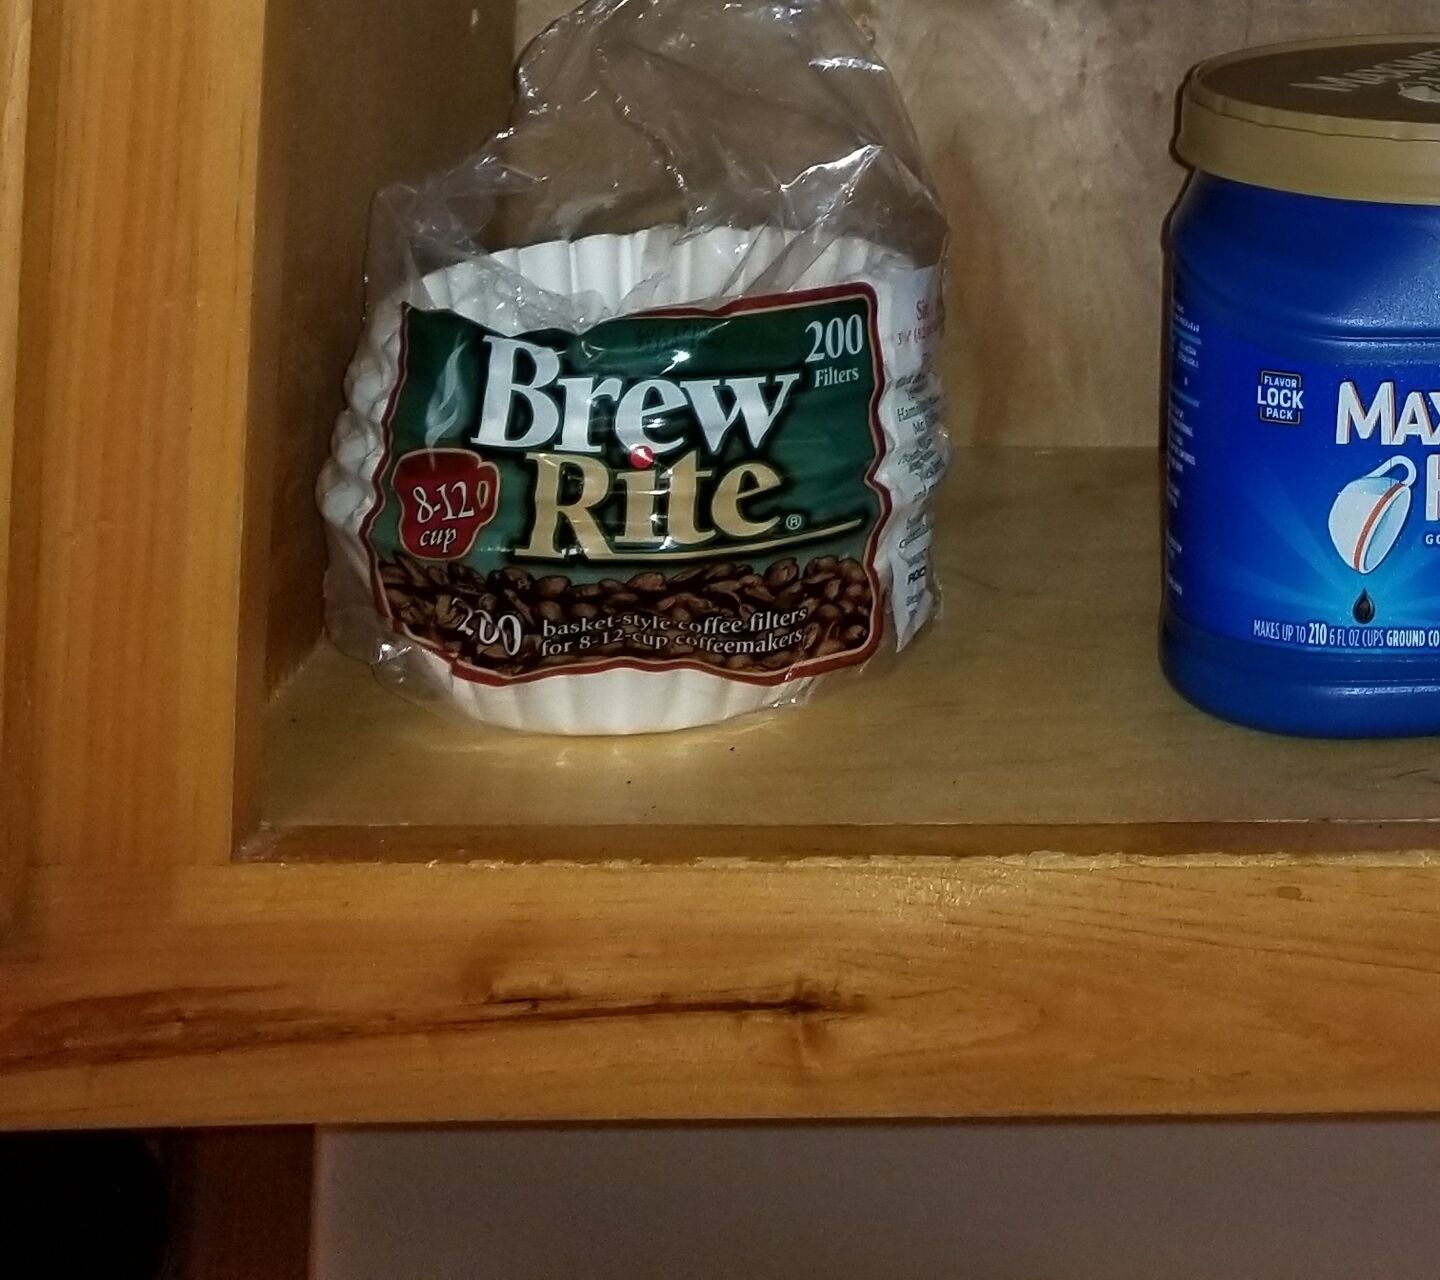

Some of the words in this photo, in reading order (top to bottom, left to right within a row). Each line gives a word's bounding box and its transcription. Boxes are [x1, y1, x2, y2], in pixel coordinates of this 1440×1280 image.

[804, 313, 864, 364] 200
[814, 366, 859, 389] Filters
[1264, 375, 1298, 388] FLAVOR
[470, 335, 800, 454] Brew
[1257, 385, 1304, 410] LOCK
[1266, 408, 1293, 421] PACK
[413, 480, 476, 524] 8-12
[515, 444, 783, 560] Rite
[419, 525, 457, 553] cup
[452, 597, 522, 656] 200
[543, 613, 671, 637] basket-style
[678, 616, 743, 635] coffee
[750, 607, 808, 632] filters
[1253, 619, 1280, 640] MAKES
[1282, 624, 1294, 641] UP
[1296, 626, 1307, 644] TO
[1308, 622, 1327, 646] 210
[1329, 627, 1335, 646] 6
[1337, 628, 1347, 647] FL
[1349, 629, 1360, 647] OZ
[1362, 628, 1384, 647] CUPS
[1386, 629, 1425, 647] GROUND
[541, 640, 573, 657] for
[579, 629, 668, 650] 8-12-cup
[676, 628, 803, 654] coffeemakers
